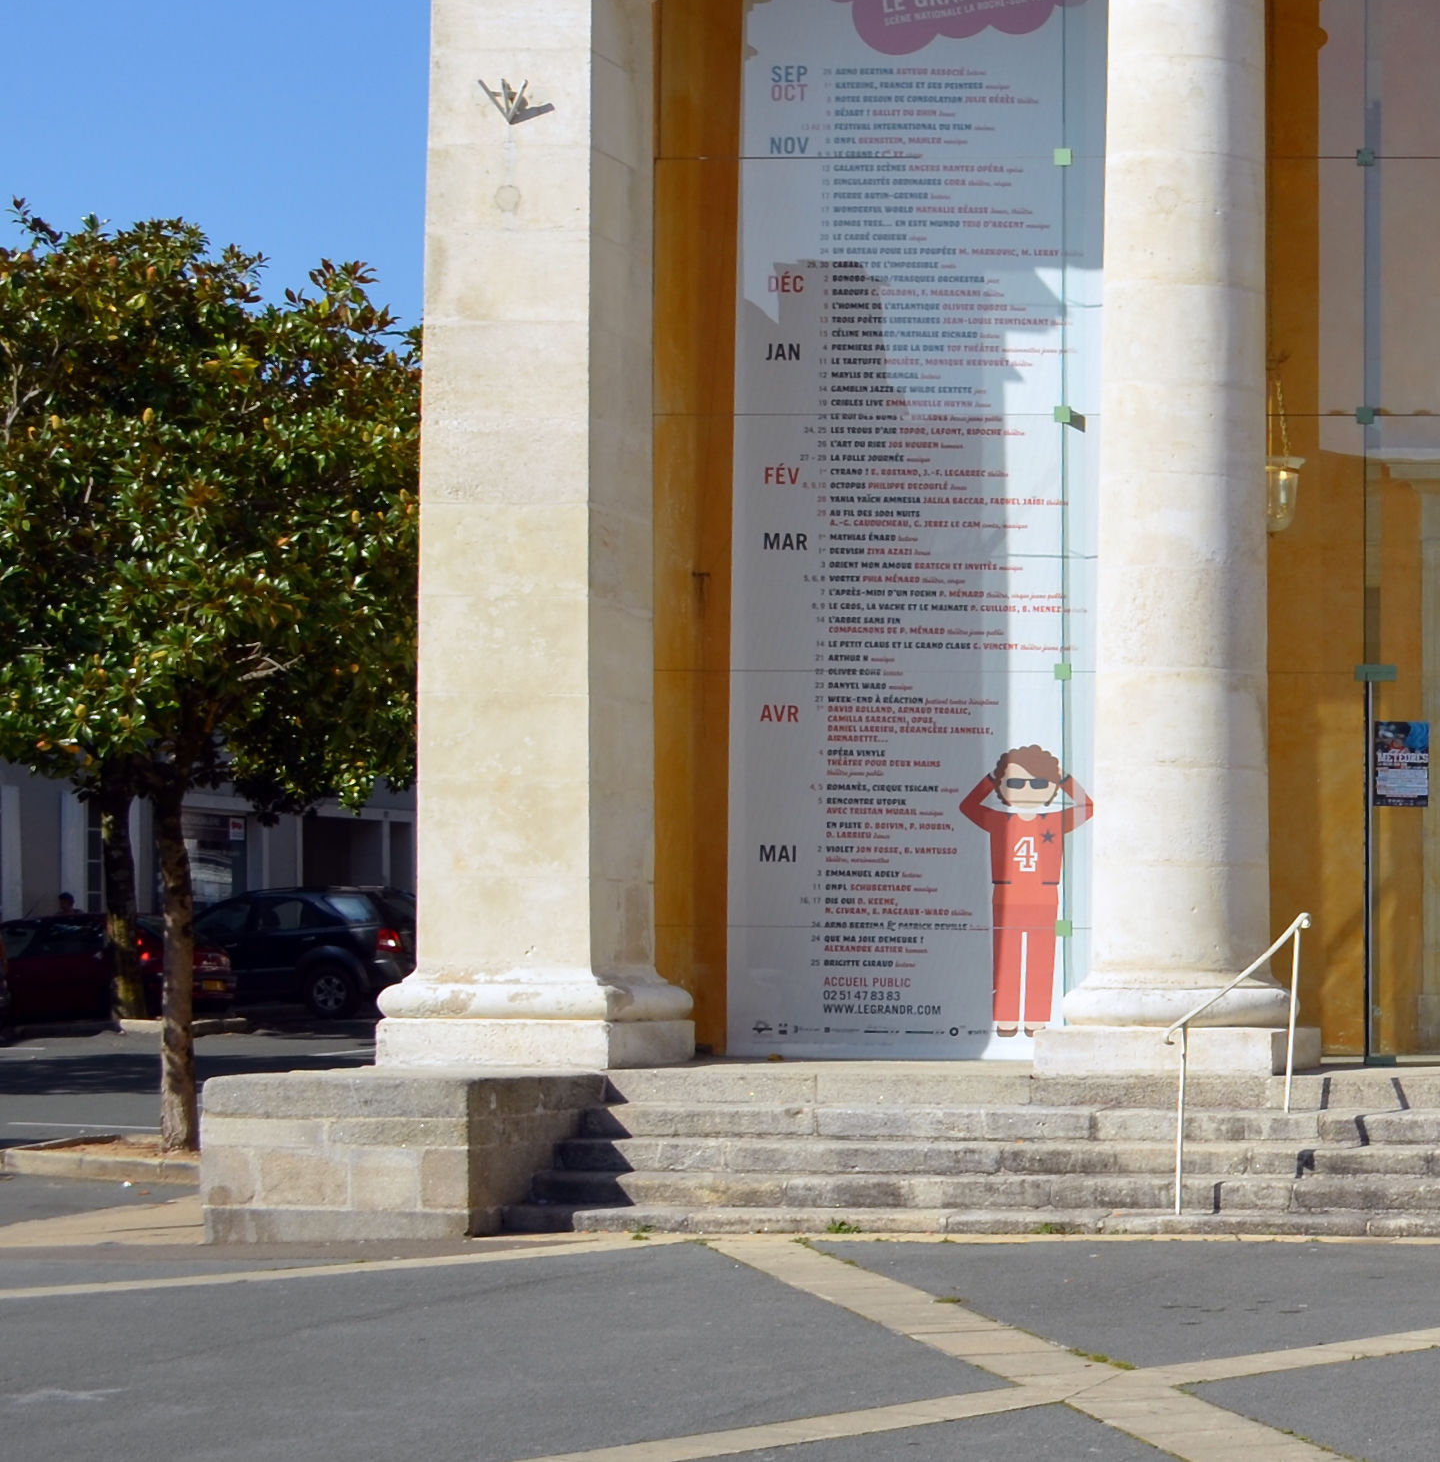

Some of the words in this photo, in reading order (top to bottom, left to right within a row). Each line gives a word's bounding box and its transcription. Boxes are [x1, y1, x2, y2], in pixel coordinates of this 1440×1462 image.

[914, 6, 962, 22] NATIONALE
[964, 4, 976, 14] LA
[771, 66, 808, 82] SEP
[771, 84, 808, 102] OCT
[769, 136, 809, 154] NOV
[768, 272, 804, 293] DÉC
[766, 343, 801, 360] JAN
[764, 463, 800, 485] FÉV
[763, 532, 808, 550] MAR
[760, 704, 800, 722] AVR
[759, 844, 797, 862] MAI
[1013, 836, 1038, 872] 4
[824, 977, 867, 987] ACCUEIL
[872, 977, 911, 987] PUBLIC
[823, 990, 837, 1000] 02
[838, 990, 851, 1000] 51
[853, 990, 868, 1000] 47
[869, 990, 884, 1000] 83
[886, 990, 901, 1000] 83
[823, 1004, 942, 1014] WWW.LEGRANDR.COM
